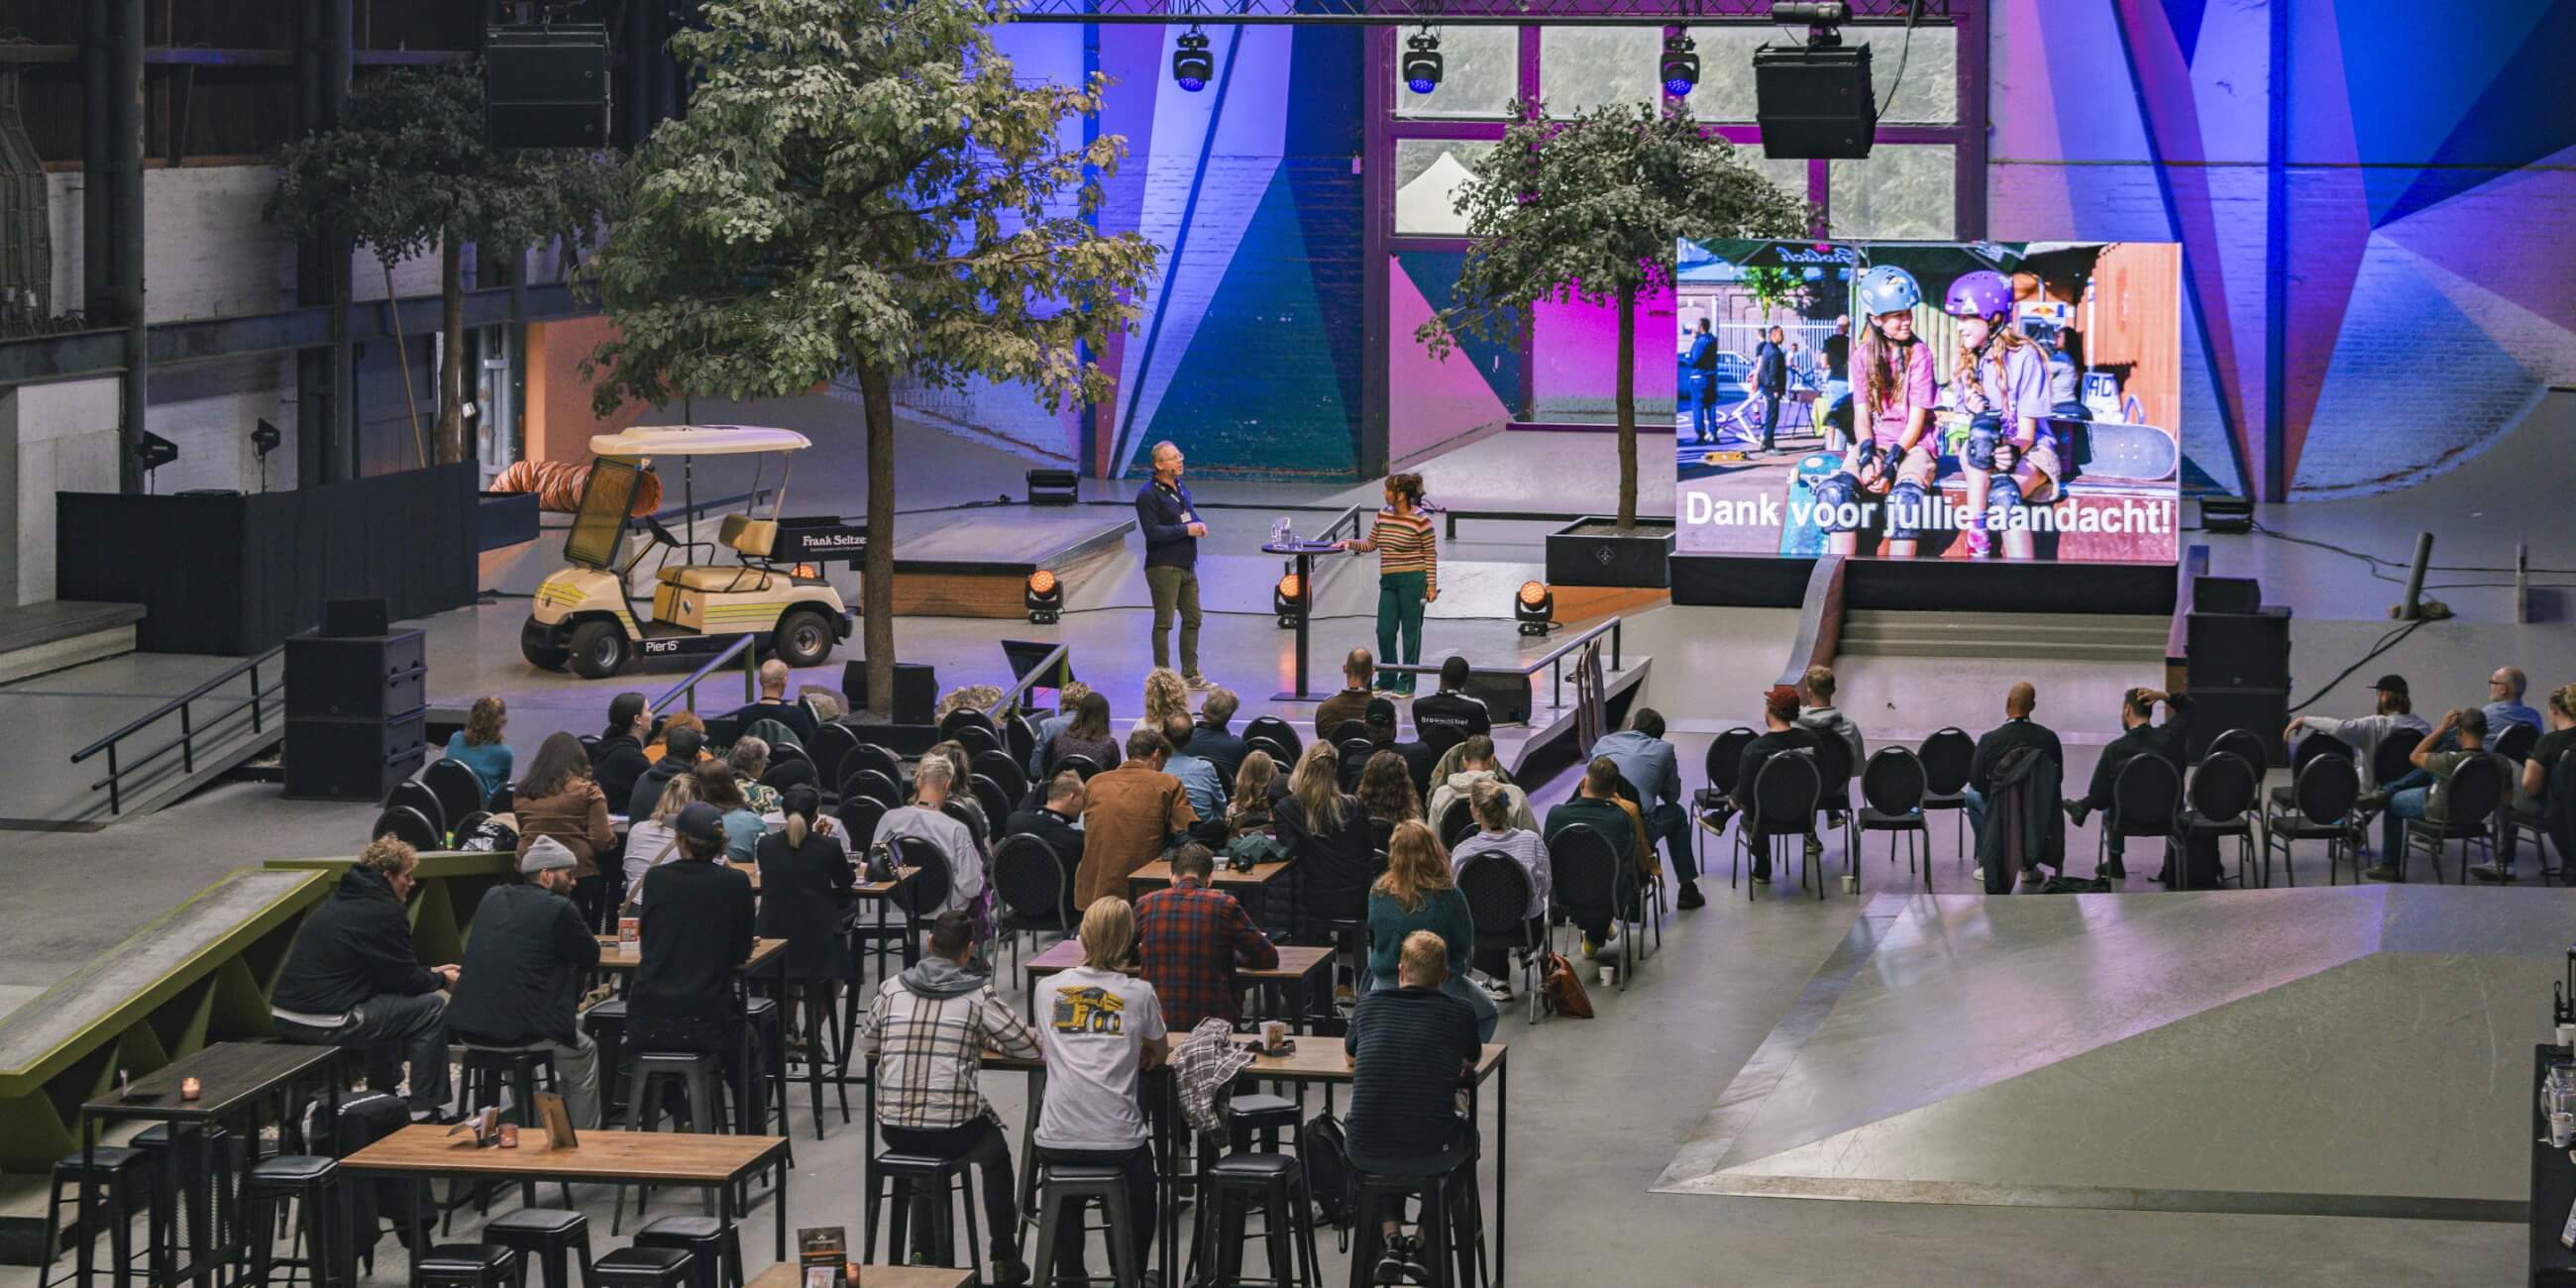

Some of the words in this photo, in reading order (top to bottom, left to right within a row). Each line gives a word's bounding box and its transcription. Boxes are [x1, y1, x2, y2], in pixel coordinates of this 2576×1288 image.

[1686, 491, 1780, 526] Dank
[1790, 501, 1878, 528] voor
[1882, 495, 1972, 538] jullie
[1986, 499, 2171, 533] aandacht!
[803, 535, 832, 546] Frank
[833, 534, 868, 545] Seltze
